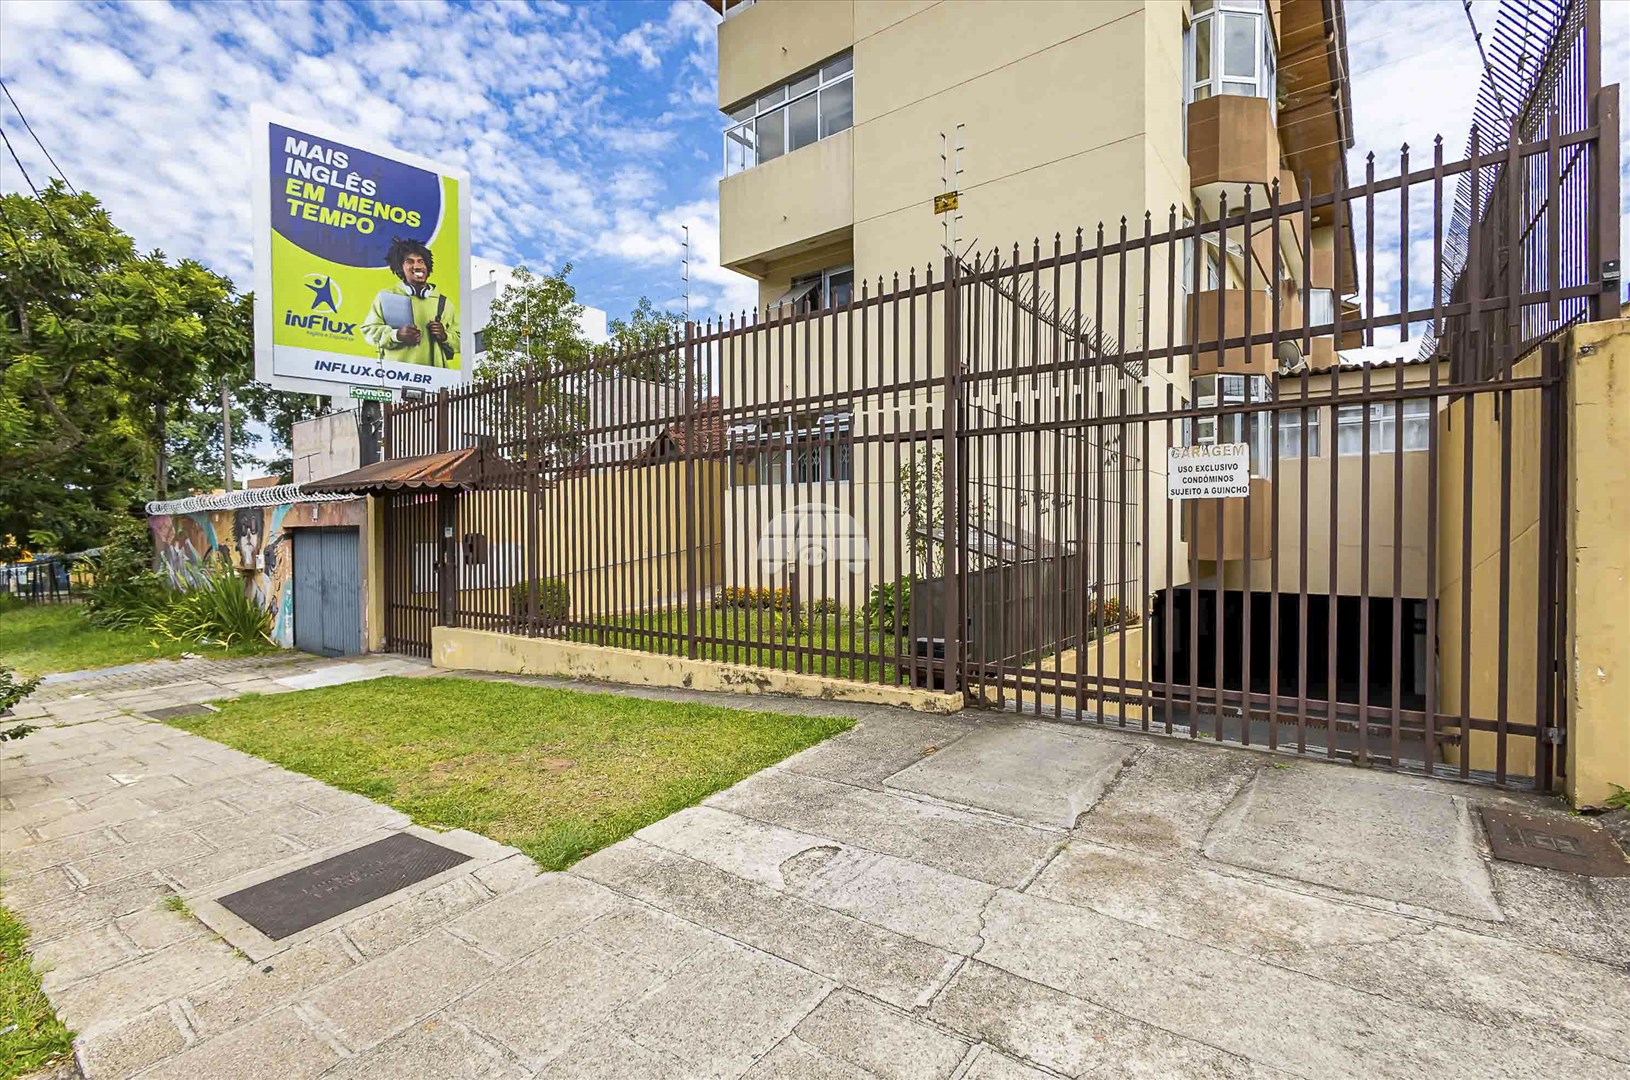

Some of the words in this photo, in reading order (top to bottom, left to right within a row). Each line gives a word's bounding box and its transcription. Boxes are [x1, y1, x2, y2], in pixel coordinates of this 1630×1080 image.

[284, 136, 349, 169] MAIS
[285, 157, 377, 196] INGLÊS
[285, 178, 326, 203] EM
[337, 192, 421, 228] MENOS
[286, 198, 375, 234] TEMPO
[314, 360, 432, 384] INFLUX.COM.BR
[1171, 444, 1244, 459] GARAGEM
[1177, 465, 1193, 473] USO
[1195, 463, 1238, 472] EXCLUSIVO
[1170, 487, 1202, 496] SUJEITO
[1204, 487, 1209, 495] A
[1211, 486, 1248, 495] GUINCHO
